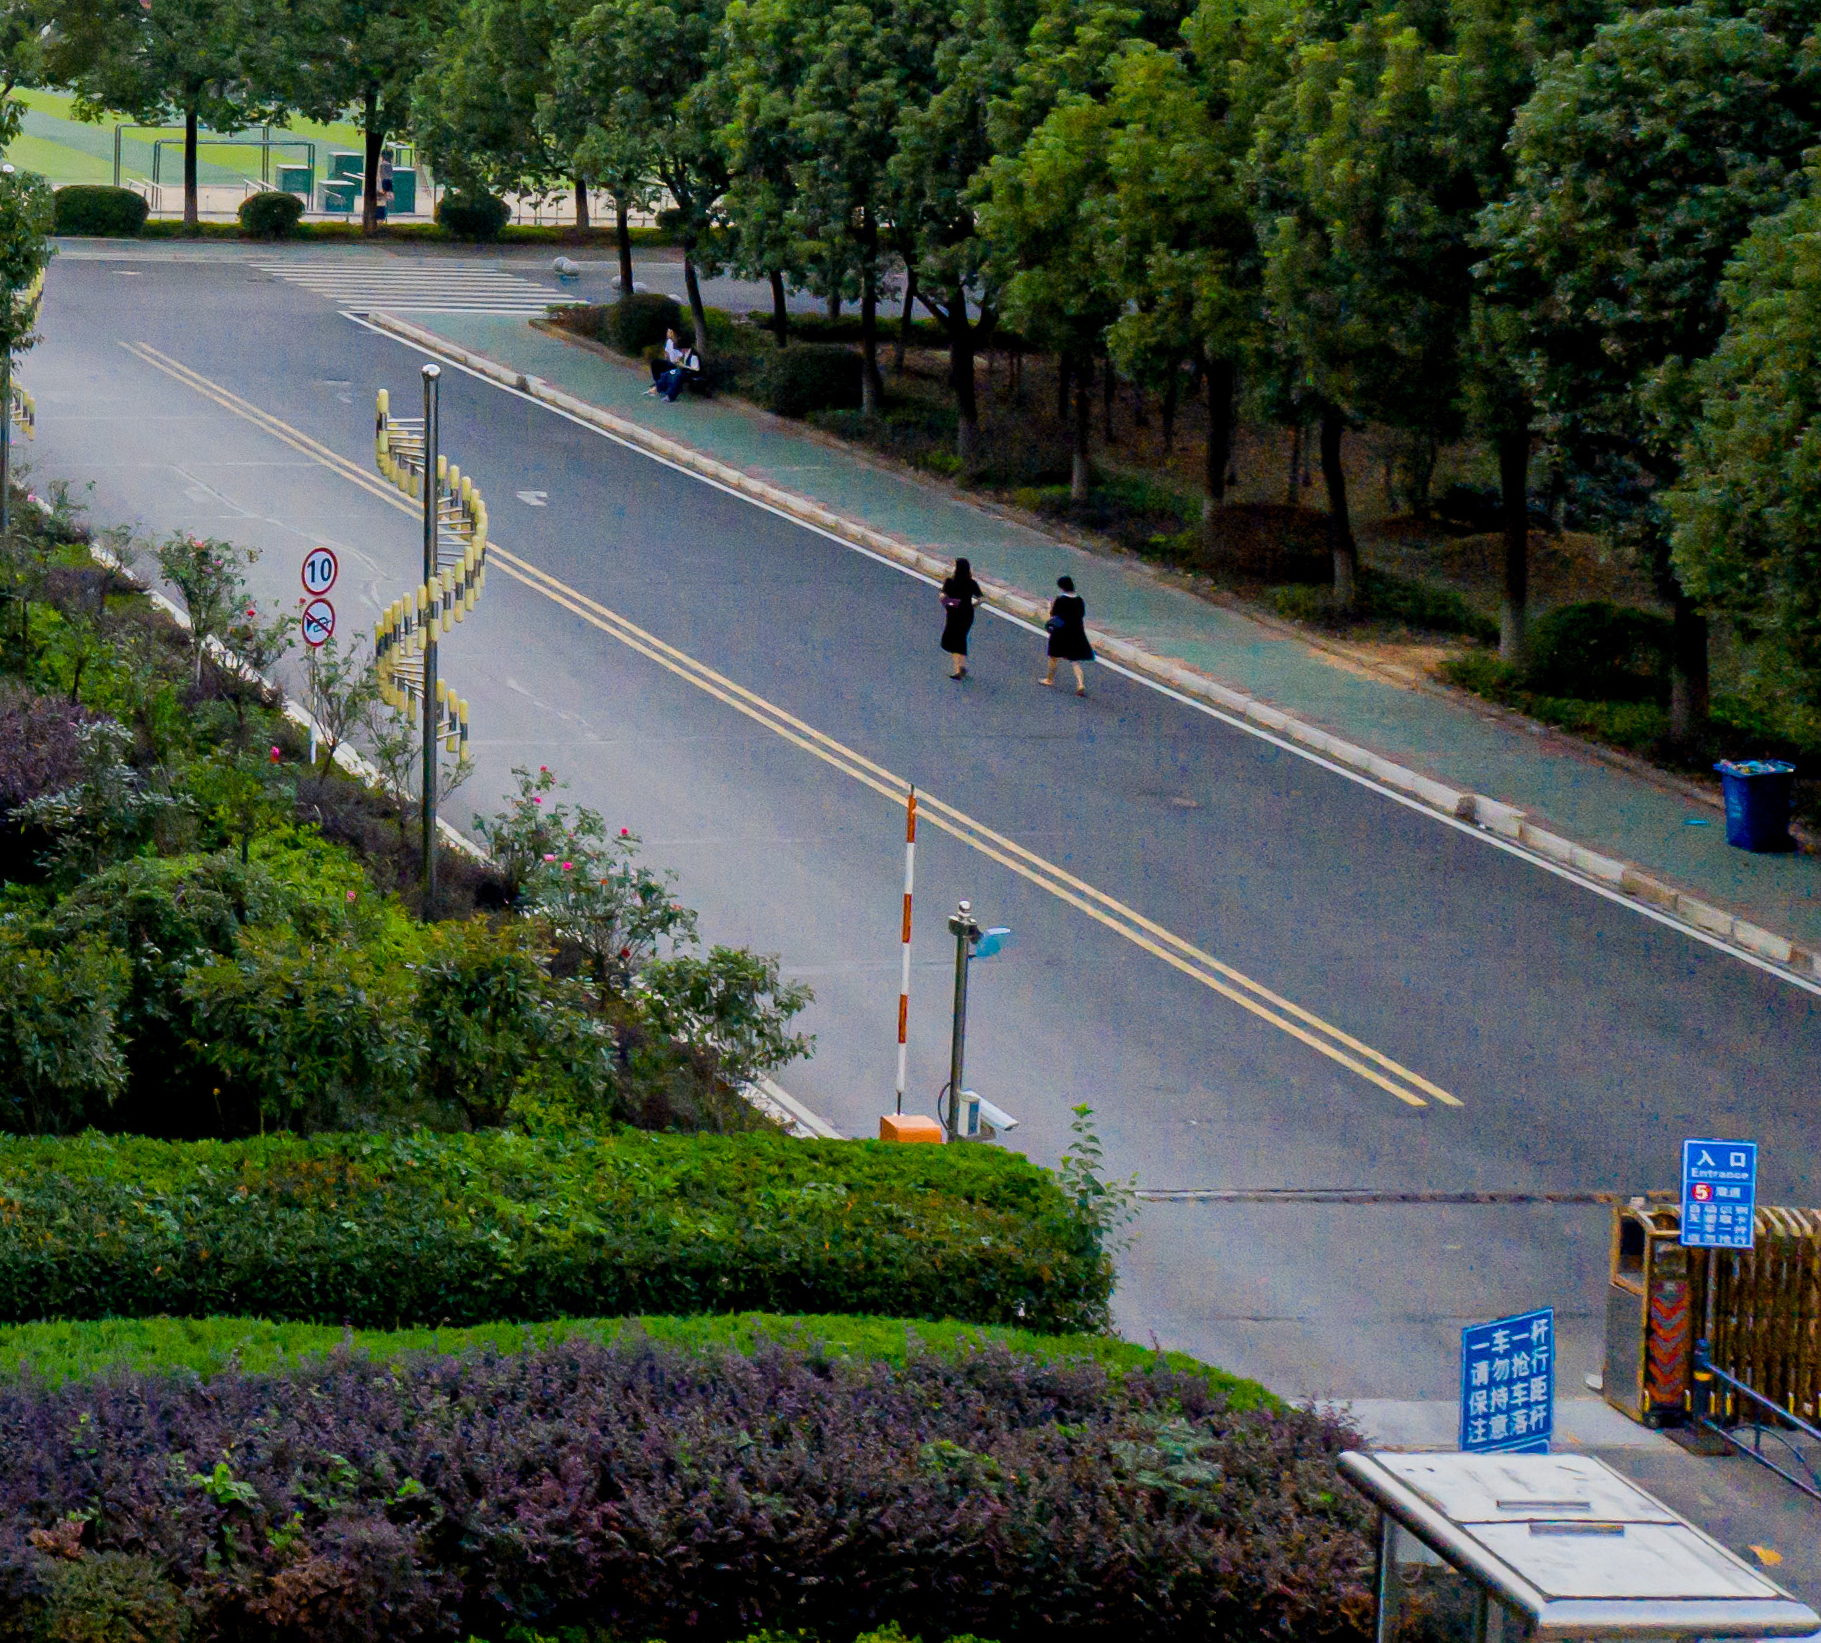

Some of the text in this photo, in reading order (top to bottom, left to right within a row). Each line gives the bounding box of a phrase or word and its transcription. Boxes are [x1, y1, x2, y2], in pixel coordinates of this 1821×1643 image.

[307, 557, 332, 583] 10
[1691, 1167, 1749, 1180] Entrance
[1697, 1149, 1747, 1168] 入口
[1470, 1318, 1549, 1354] 一车一杆
[1471, 1346, 1549, 1387] 请勿抢行
[1468, 1374, 1548, 1416] 保持车距
[1467, 1403, 1547, 1444] 注意落杆
